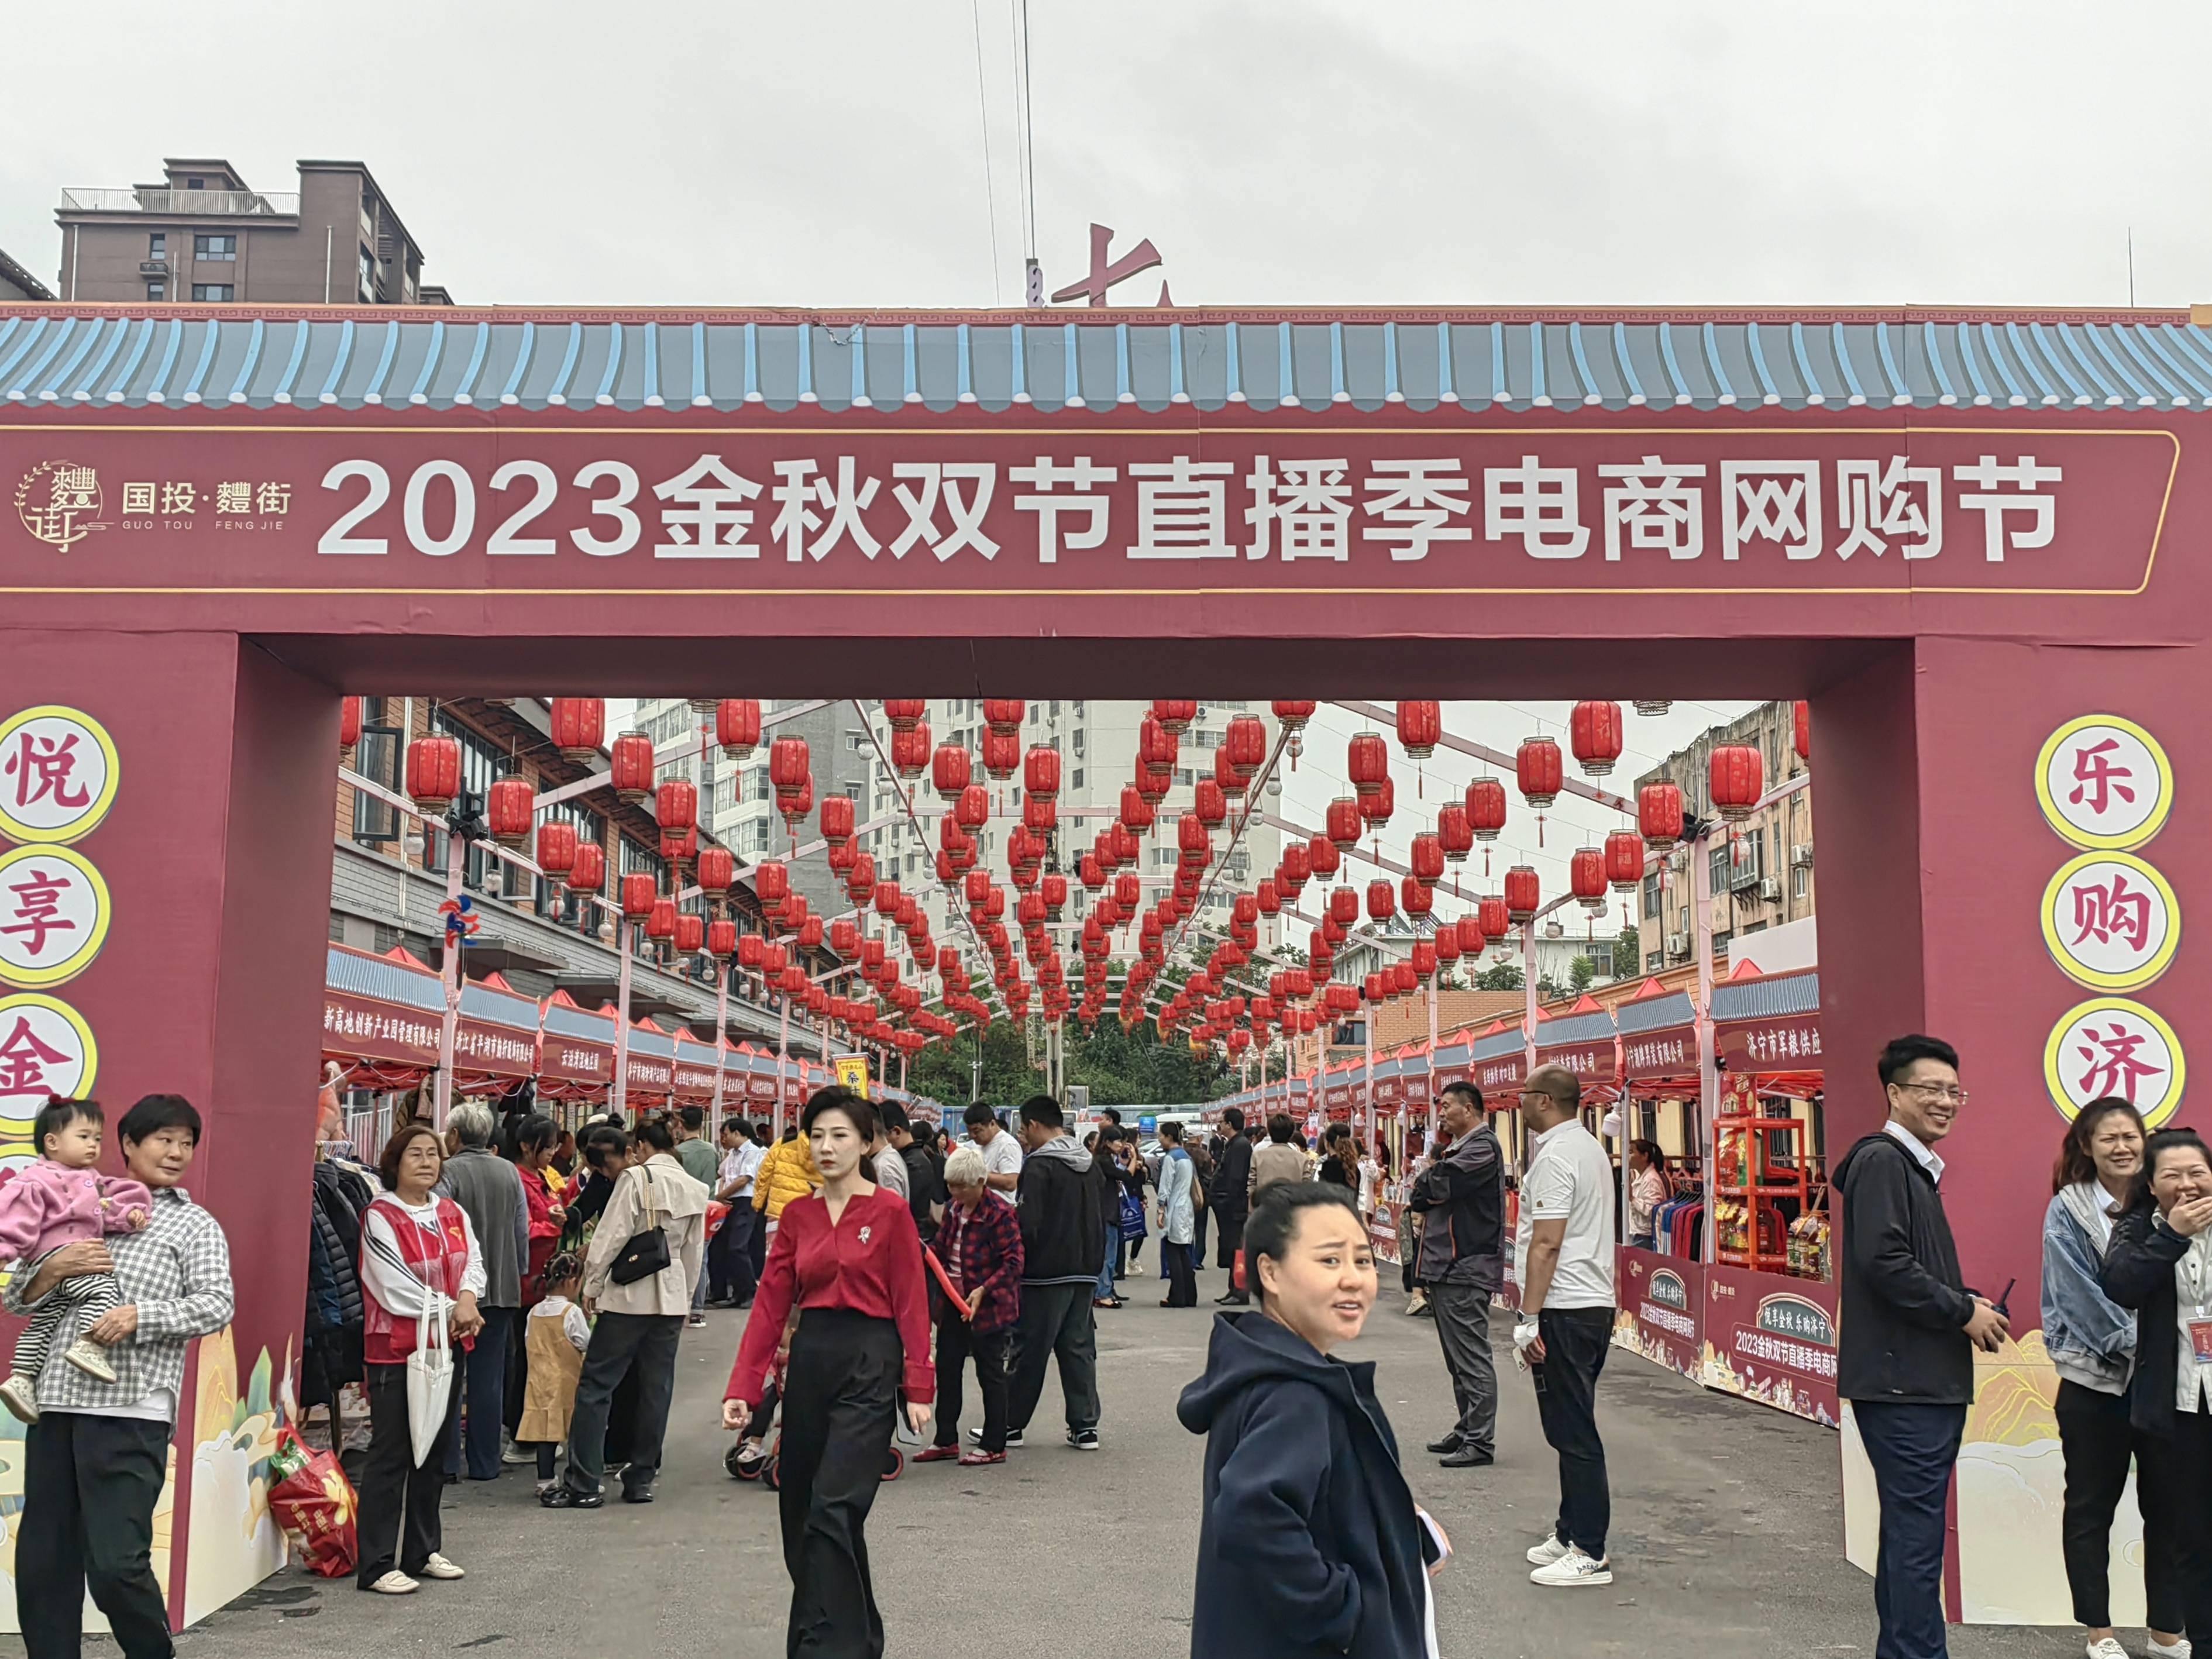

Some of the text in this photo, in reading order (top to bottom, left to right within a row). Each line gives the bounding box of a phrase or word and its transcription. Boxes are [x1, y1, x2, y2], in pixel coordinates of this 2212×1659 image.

[122, 520, 283, 530] GUO TOU FENG JIE
[318, 454, 2062, 563] 2023金秋双节直播季电商网购节
[324, 1006, 441, 1049] 新高地创新产业园管理有限公司
[1746, 1028, 1822, 1060] 济宁市军粮供应
[1764, 1306, 1826, 1339] 悦享金秋 乐购济宁
